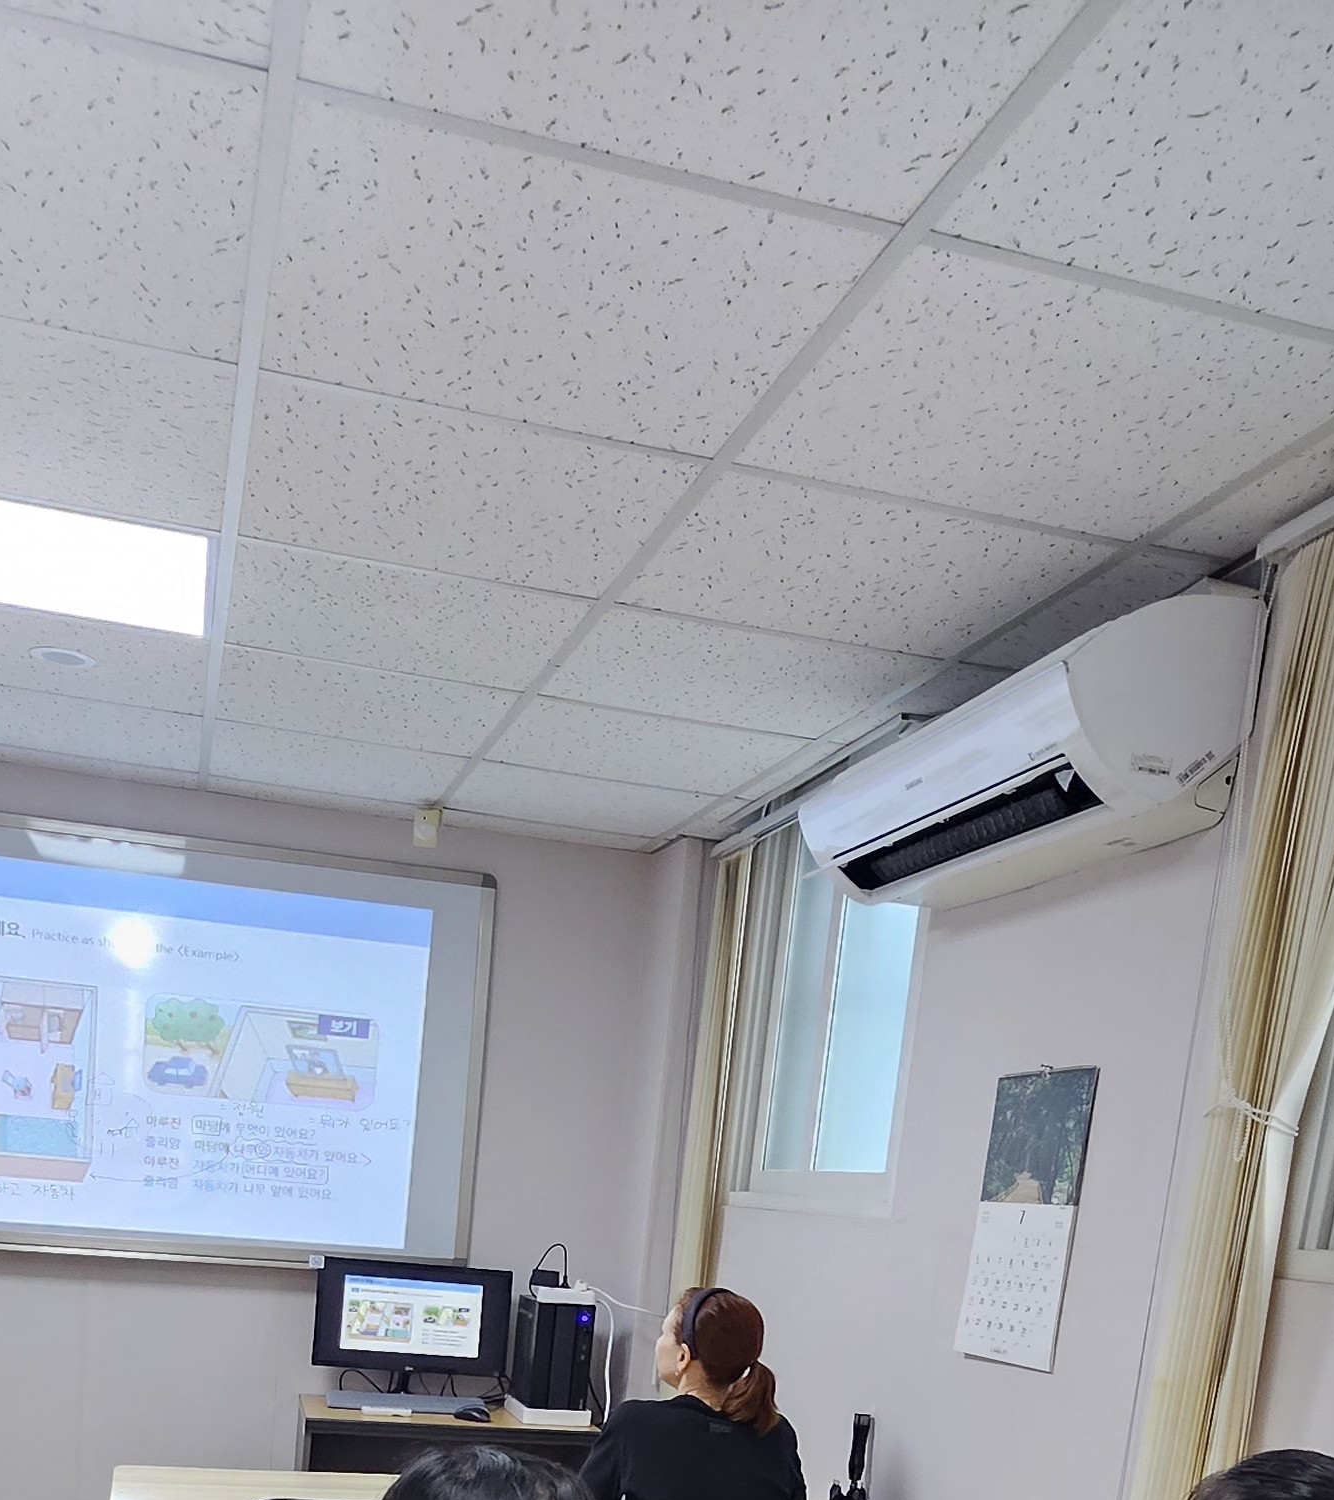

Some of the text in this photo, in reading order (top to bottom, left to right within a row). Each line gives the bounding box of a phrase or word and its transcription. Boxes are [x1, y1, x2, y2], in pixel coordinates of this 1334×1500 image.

[31, 928, 81, 945] Practice
[82, 937, 95, 945] as
[156, 943, 174, 954] the
[330, 1019, 357, 1036] 보기
[236, 1122, 270, 1136] 무엇이
[275, 1125, 316, 1139] 있어요?
[244, 1163, 278, 1177] 어디에
[31, 1184, 75, 1201] 자동차
[243, 1183, 265, 1195] 나무
[1020, 1210, 1026, 1224] 7
